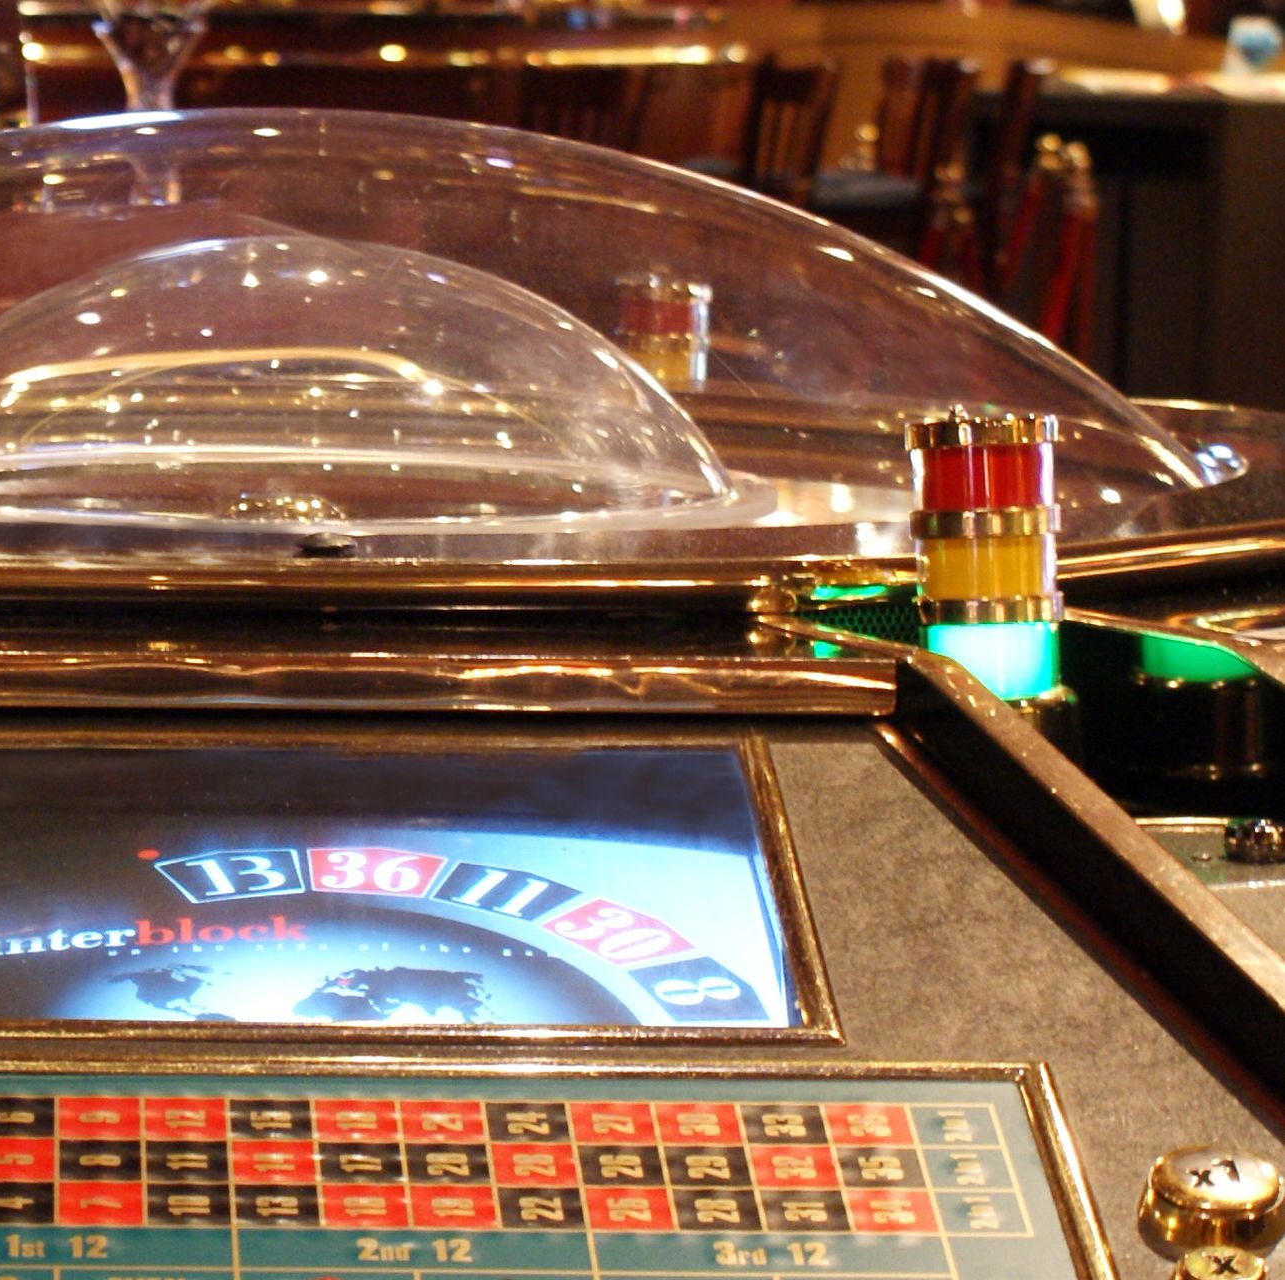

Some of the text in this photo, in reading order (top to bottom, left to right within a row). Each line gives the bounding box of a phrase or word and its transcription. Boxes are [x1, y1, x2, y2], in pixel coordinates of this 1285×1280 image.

[181, 853, 282, 896] 13
[321, 850, 422, 892] 36
[459, 866, 551, 919] 11
[557, 904, 668, 964] 30
[653, 976, 742, 1007] 8
[6, 1234, 108, 1259] 1st 12
[356, 1237, 473, 1263] 2nd 12
[713, 1241, 830, 1266] 3rd 12
